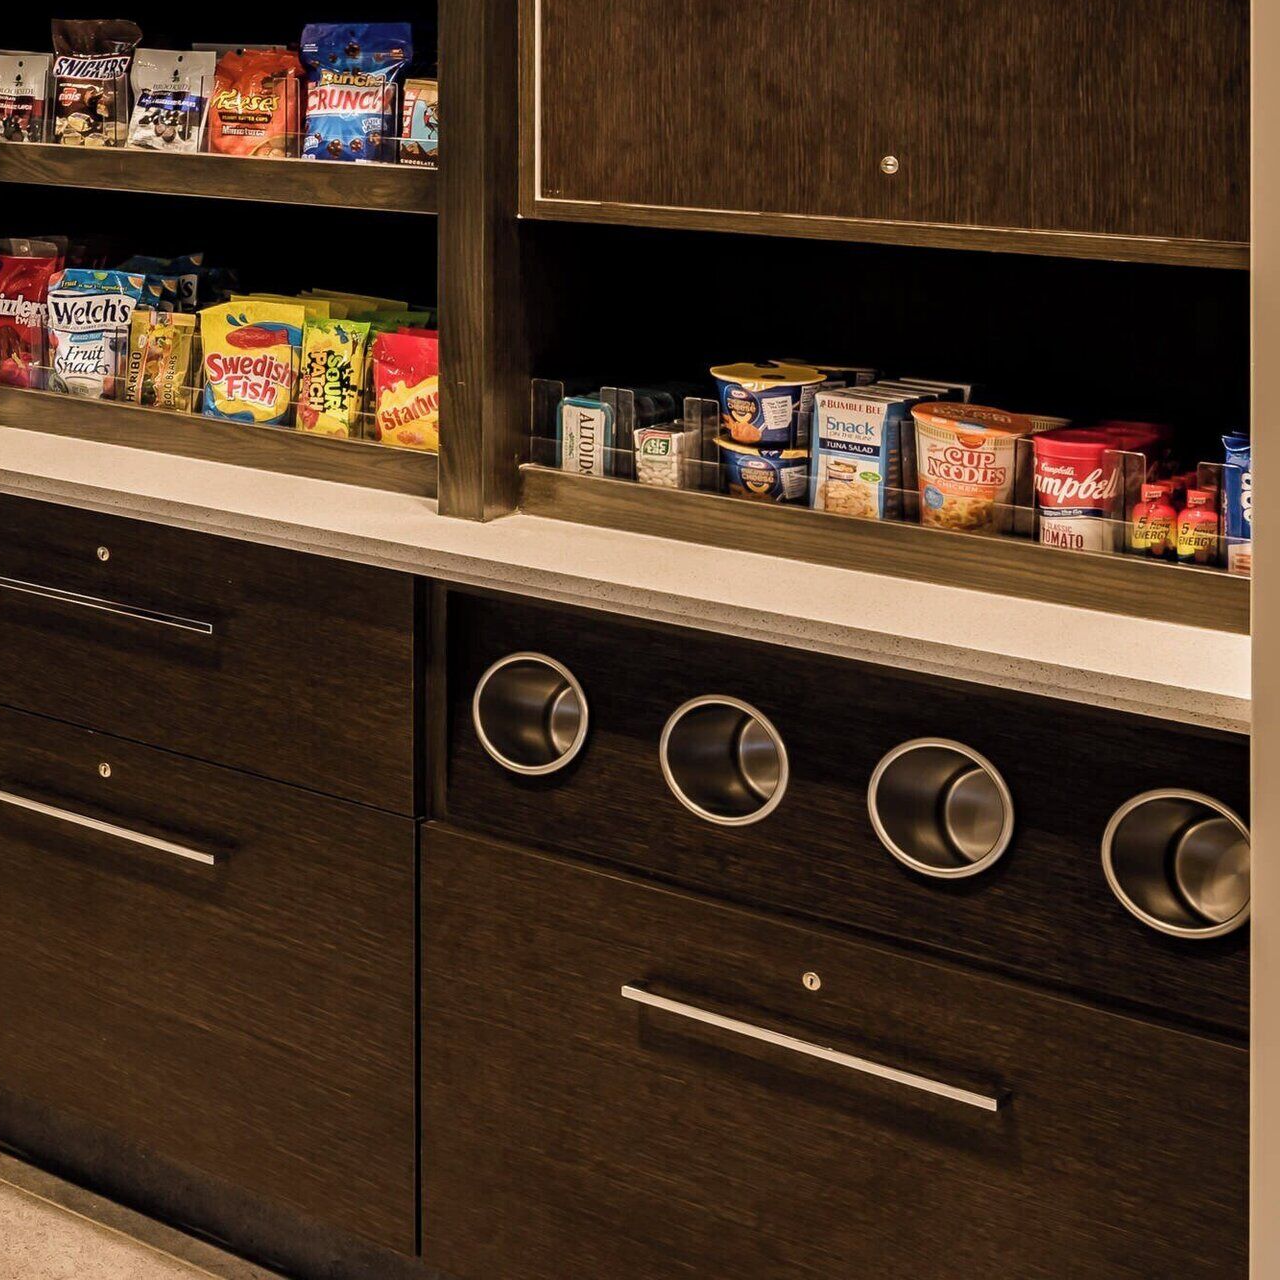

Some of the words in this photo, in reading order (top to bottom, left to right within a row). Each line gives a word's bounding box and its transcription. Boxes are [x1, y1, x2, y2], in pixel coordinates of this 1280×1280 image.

[56, 57, 127, 79] SNICKERS
[307, 87, 392, 114] CRUNCH
[52, 297, 131, 325] Welch's
[64, 345, 104, 361] Fruit
[56, 357, 110, 376] Snacks
[125, 352, 141, 402] HARIBO
[168, 355, 178, 381] BEARS
[206, 353, 297, 390] Swedish
[226, 376, 277, 407] Fish
[308, 350, 326, 412] PATCH
[326, 354, 342, 411] SOUR
[164, 380, 173, 409] GOLD
[827, 399, 862, 412] BUMBLE
[866, 406, 882, 415] BEE
[827, 416, 874, 436] Snack
[826, 441, 847, 450] TUNA
[849, 444, 874, 454] SALAD
[944, 447, 995, 468] CUP
[928, 457, 1006, 486] NOODLES
[1048, 523, 1072, 533] CLASSIC
[1138, 517, 1148, 530] 5
[1181, 522, 1189, 535] 5
[1042, 528, 1084, 549] TOMATO
[1134, 530, 1170, 540] ENERGY
[1178, 536, 1213, 548] ENERGY
